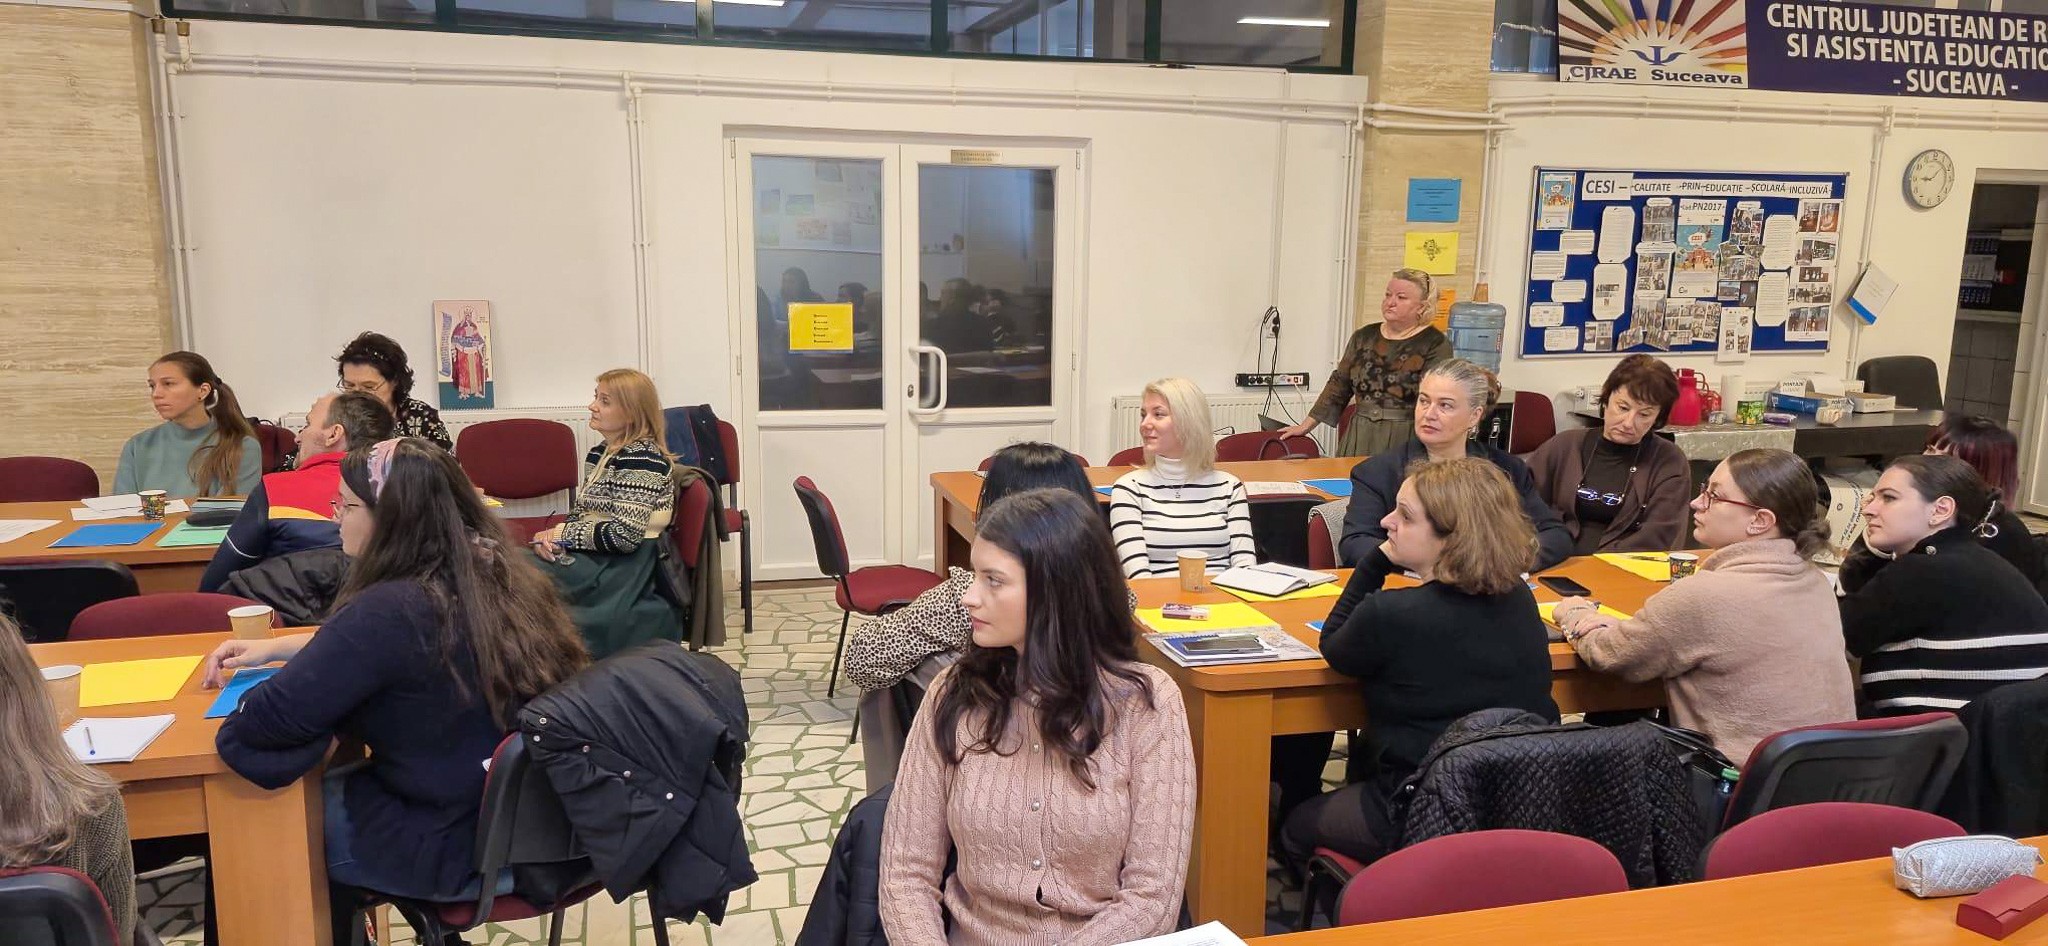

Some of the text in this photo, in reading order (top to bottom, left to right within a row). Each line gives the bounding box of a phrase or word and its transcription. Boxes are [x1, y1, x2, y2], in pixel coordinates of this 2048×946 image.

[1766, 3, 1875, 33] CENTRUL
[1878, 10, 1995, 40] JUDETEAN
[2000, 17, 2028, 42] DE
[1786, 33, 1808, 58] SI
[1814, 34, 1940, 65] ASISTENTA
[1569, 65, 1743, 84] CJRAE Suceava
[1905, 68, 2007, 96] SUCEAVA
[1585, 180, 1615, 194] CESI
[1634, 183, 1671, 192] CALITATE
[1692, 202, 1722, 211] PN2017
